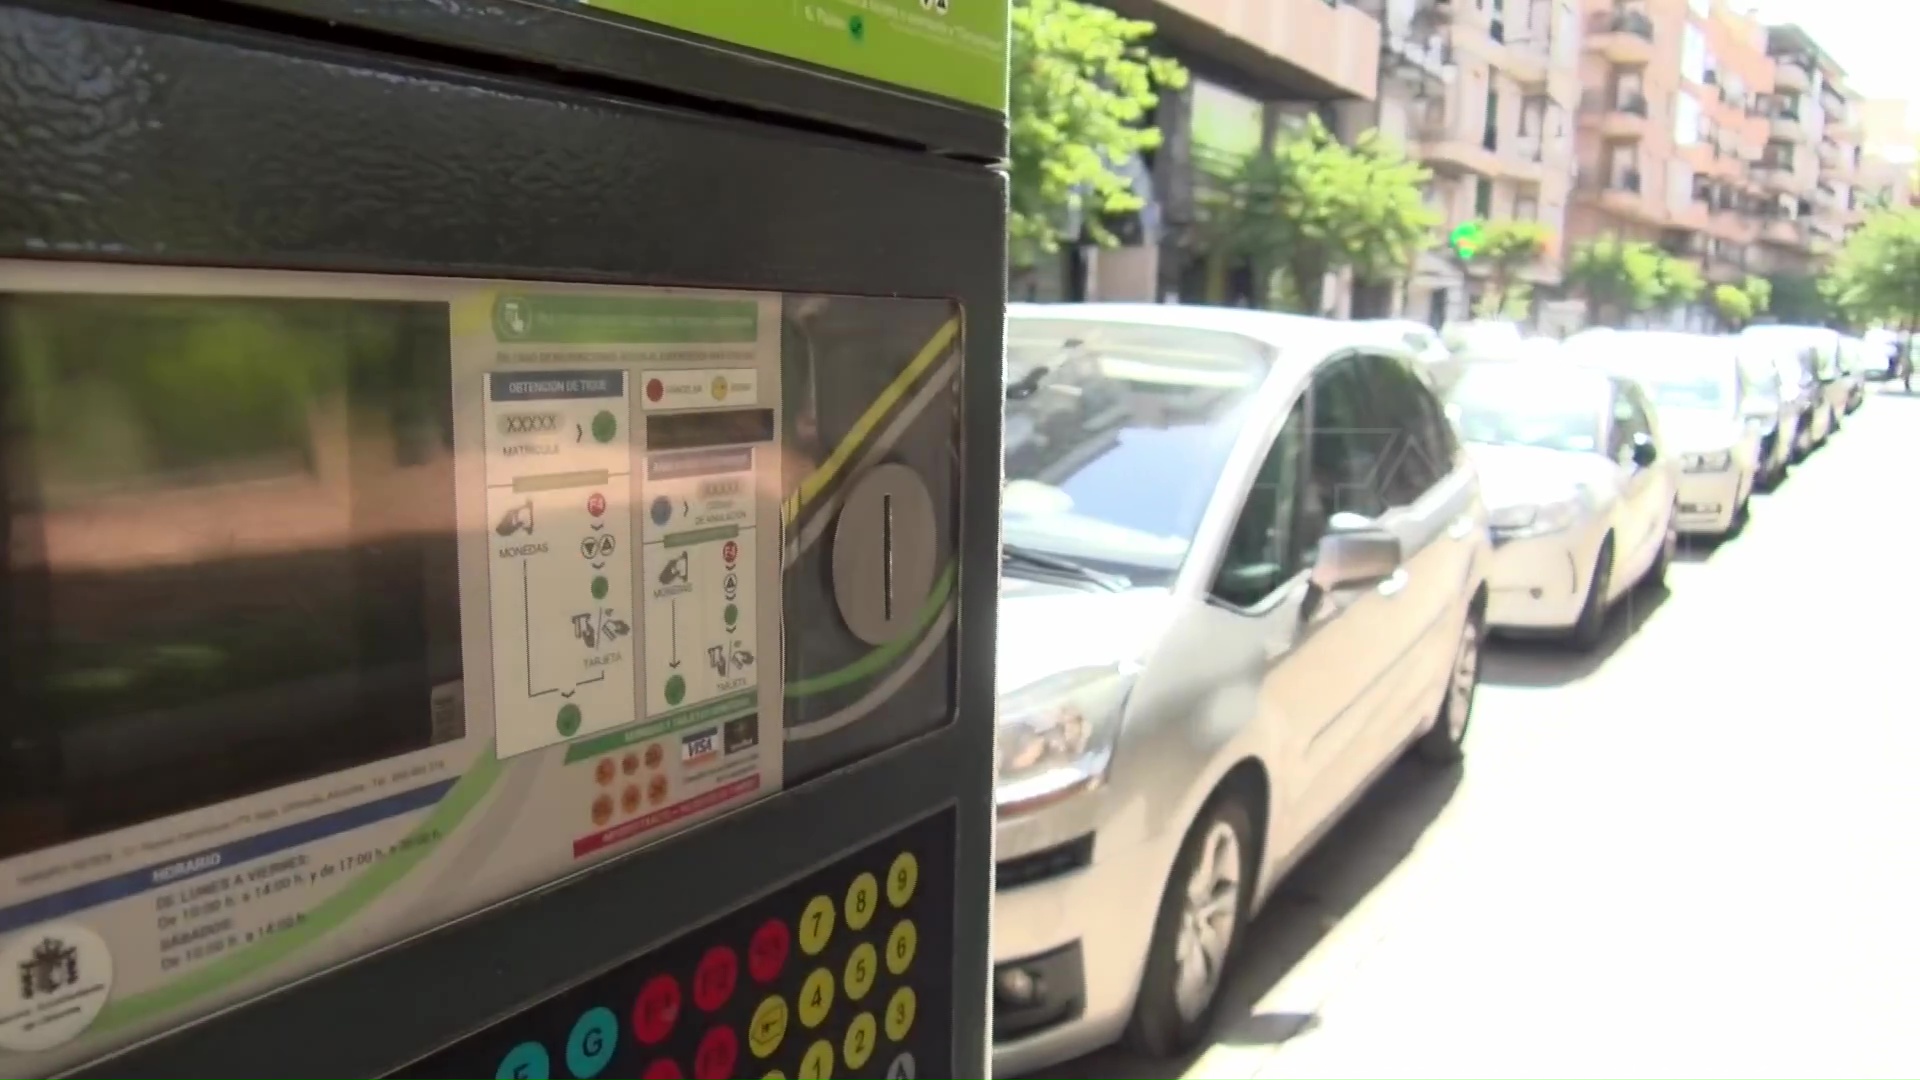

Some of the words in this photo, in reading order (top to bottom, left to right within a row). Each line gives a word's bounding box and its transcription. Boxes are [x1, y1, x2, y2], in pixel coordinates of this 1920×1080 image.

[499, 543, 549, 558] MONEDAS
[583, 651, 622, 669] TARJETA
[688, 737, 713, 758] VISA
[152, 853, 221, 882] HORARIO
[320, 864, 335, 877] de
[812, 911, 822, 937] 7
[856, 889, 866, 913] 8
[897, 868, 907, 891] 9
[810, 983, 822, 1008] 4
[854, 957, 866, 984] 5
[896, 935, 907, 960] 6
[854, 1029, 866, 1054] 2
[895, 1001, 906, 1025] 3
[583, 1029, 602, 1058] G
